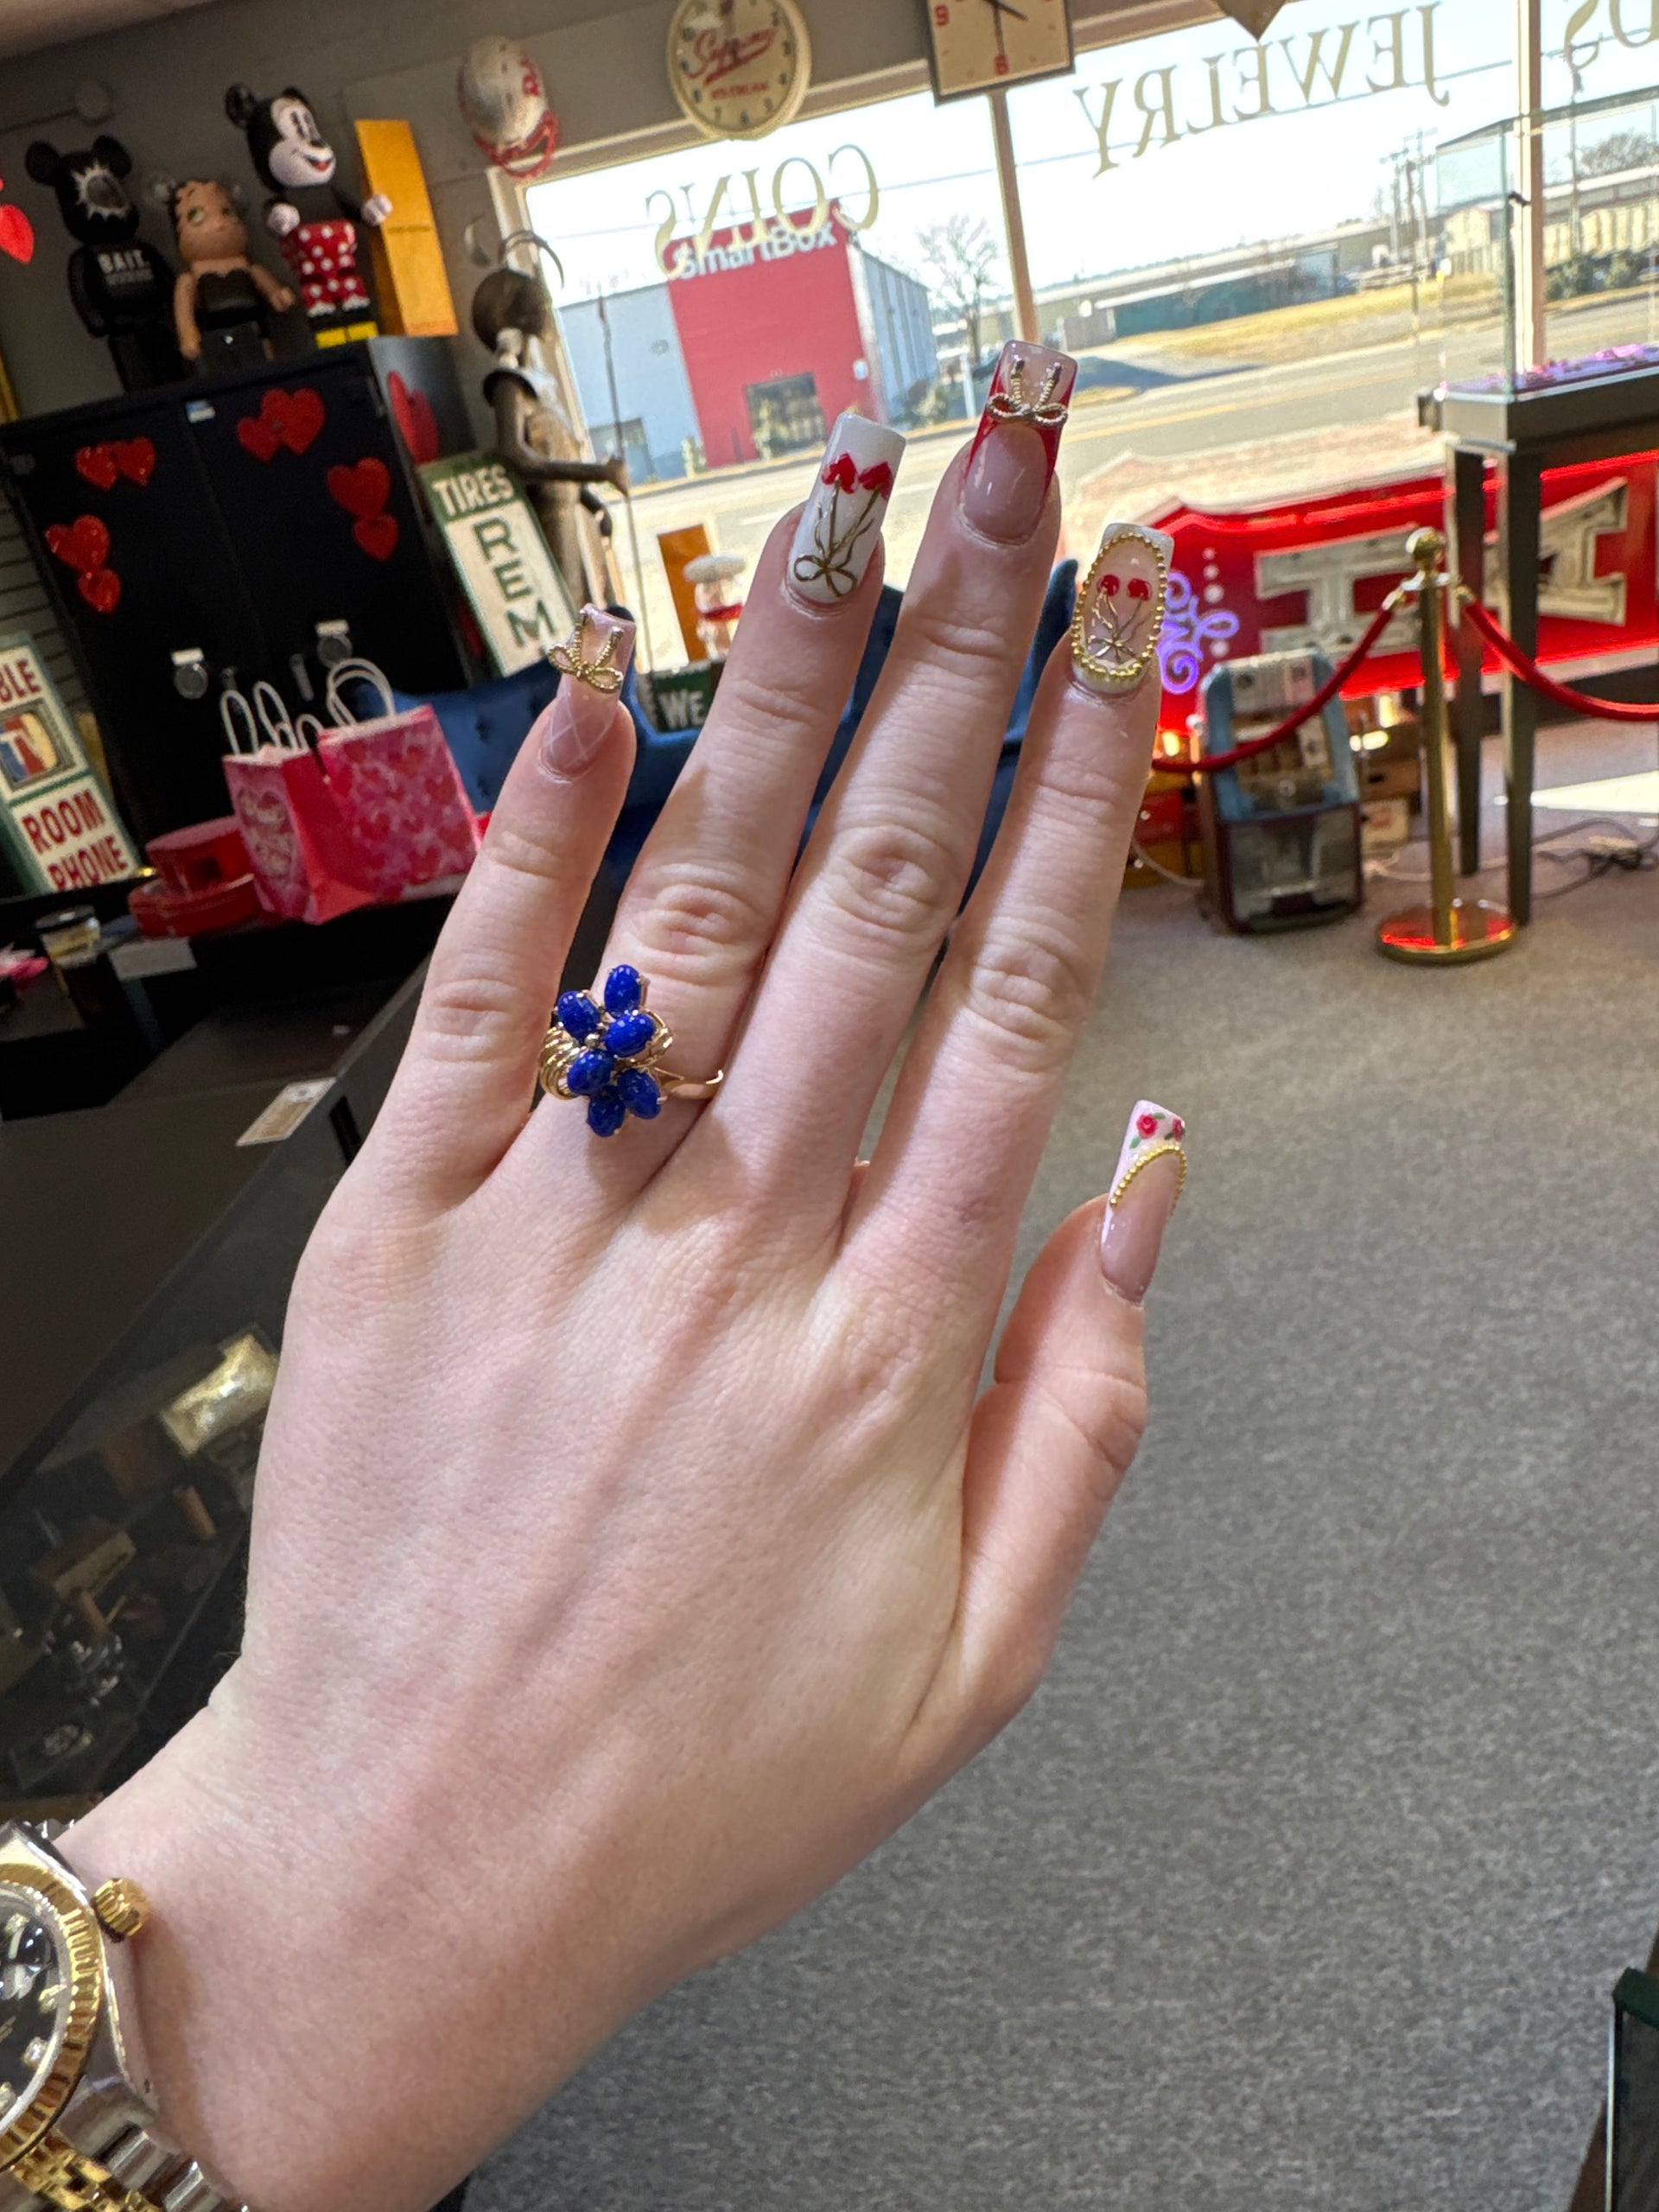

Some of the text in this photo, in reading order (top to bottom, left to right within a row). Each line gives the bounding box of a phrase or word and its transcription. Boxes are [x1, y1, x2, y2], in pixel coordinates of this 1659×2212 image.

[434, 464, 514, 517] TIRES
[22, 788, 105, 855] ROOM
[47, 836, 129, 892] PHONE
